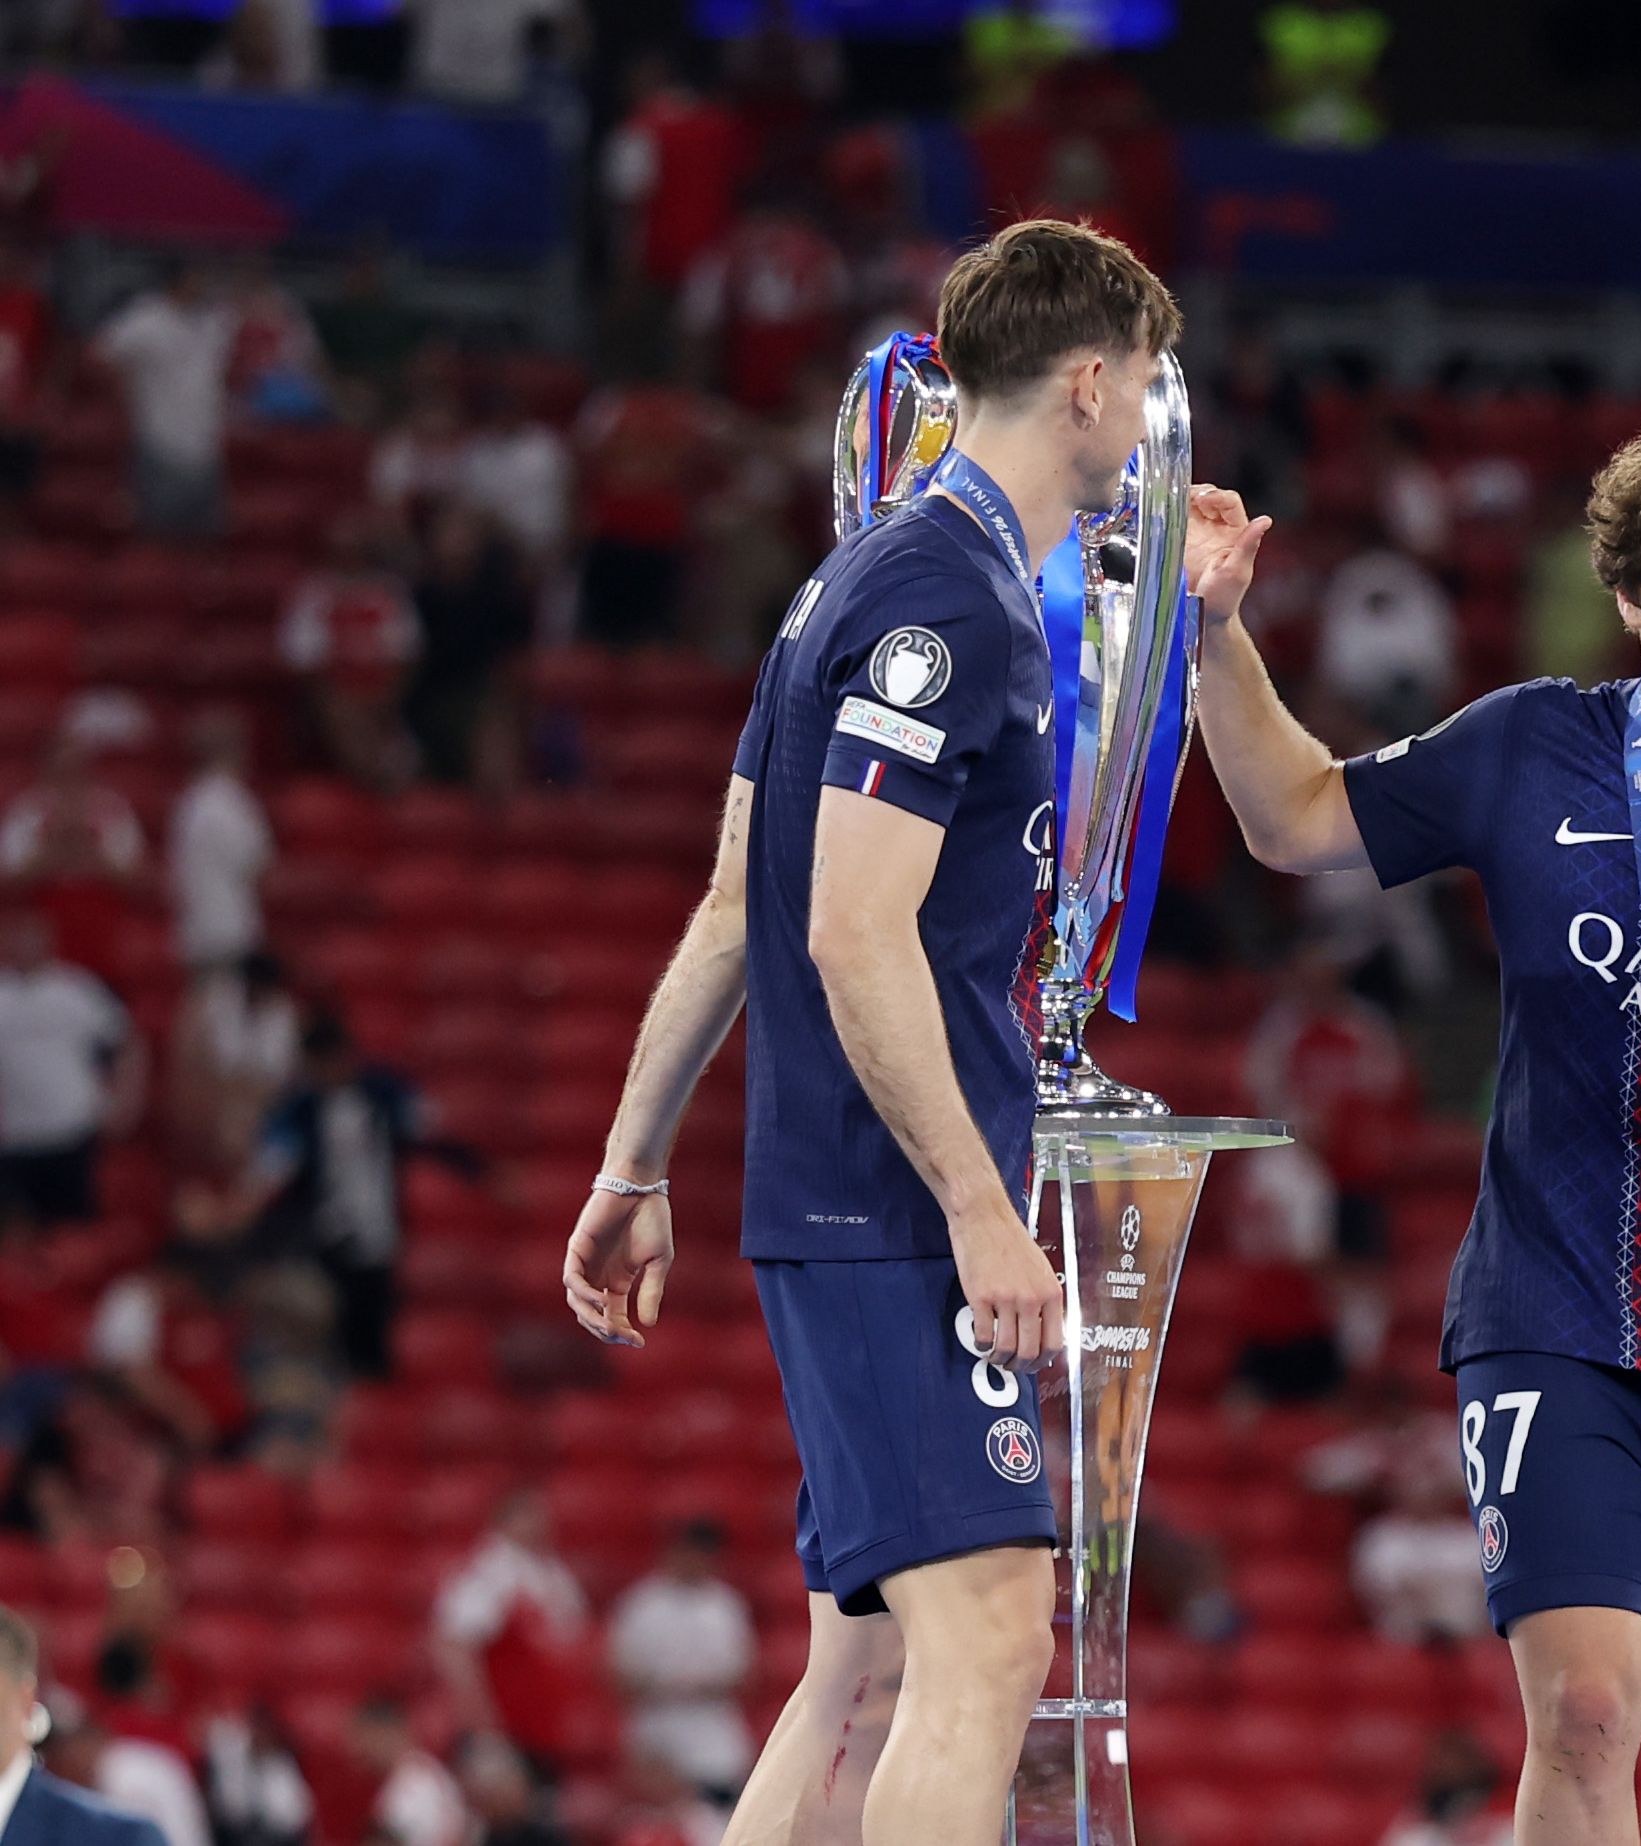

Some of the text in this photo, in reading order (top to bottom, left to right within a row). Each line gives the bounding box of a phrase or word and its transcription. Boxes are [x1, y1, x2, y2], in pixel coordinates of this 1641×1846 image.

[960, 476, 997, 516] FINAL
[841, 708, 938, 752] FOUNDATION
[1106, 1271, 1146, 1286] CHAMPIONS
[1112, 1285, 1139, 1299] LEAGUE
[1095, 1325, 1151, 1352] BUDAPEST 26
[1105, 1355, 1133, 1369] FINAL
[992, 1420, 1029, 1438] PARIS
[1462, 1391, 1542, 1507] 87
